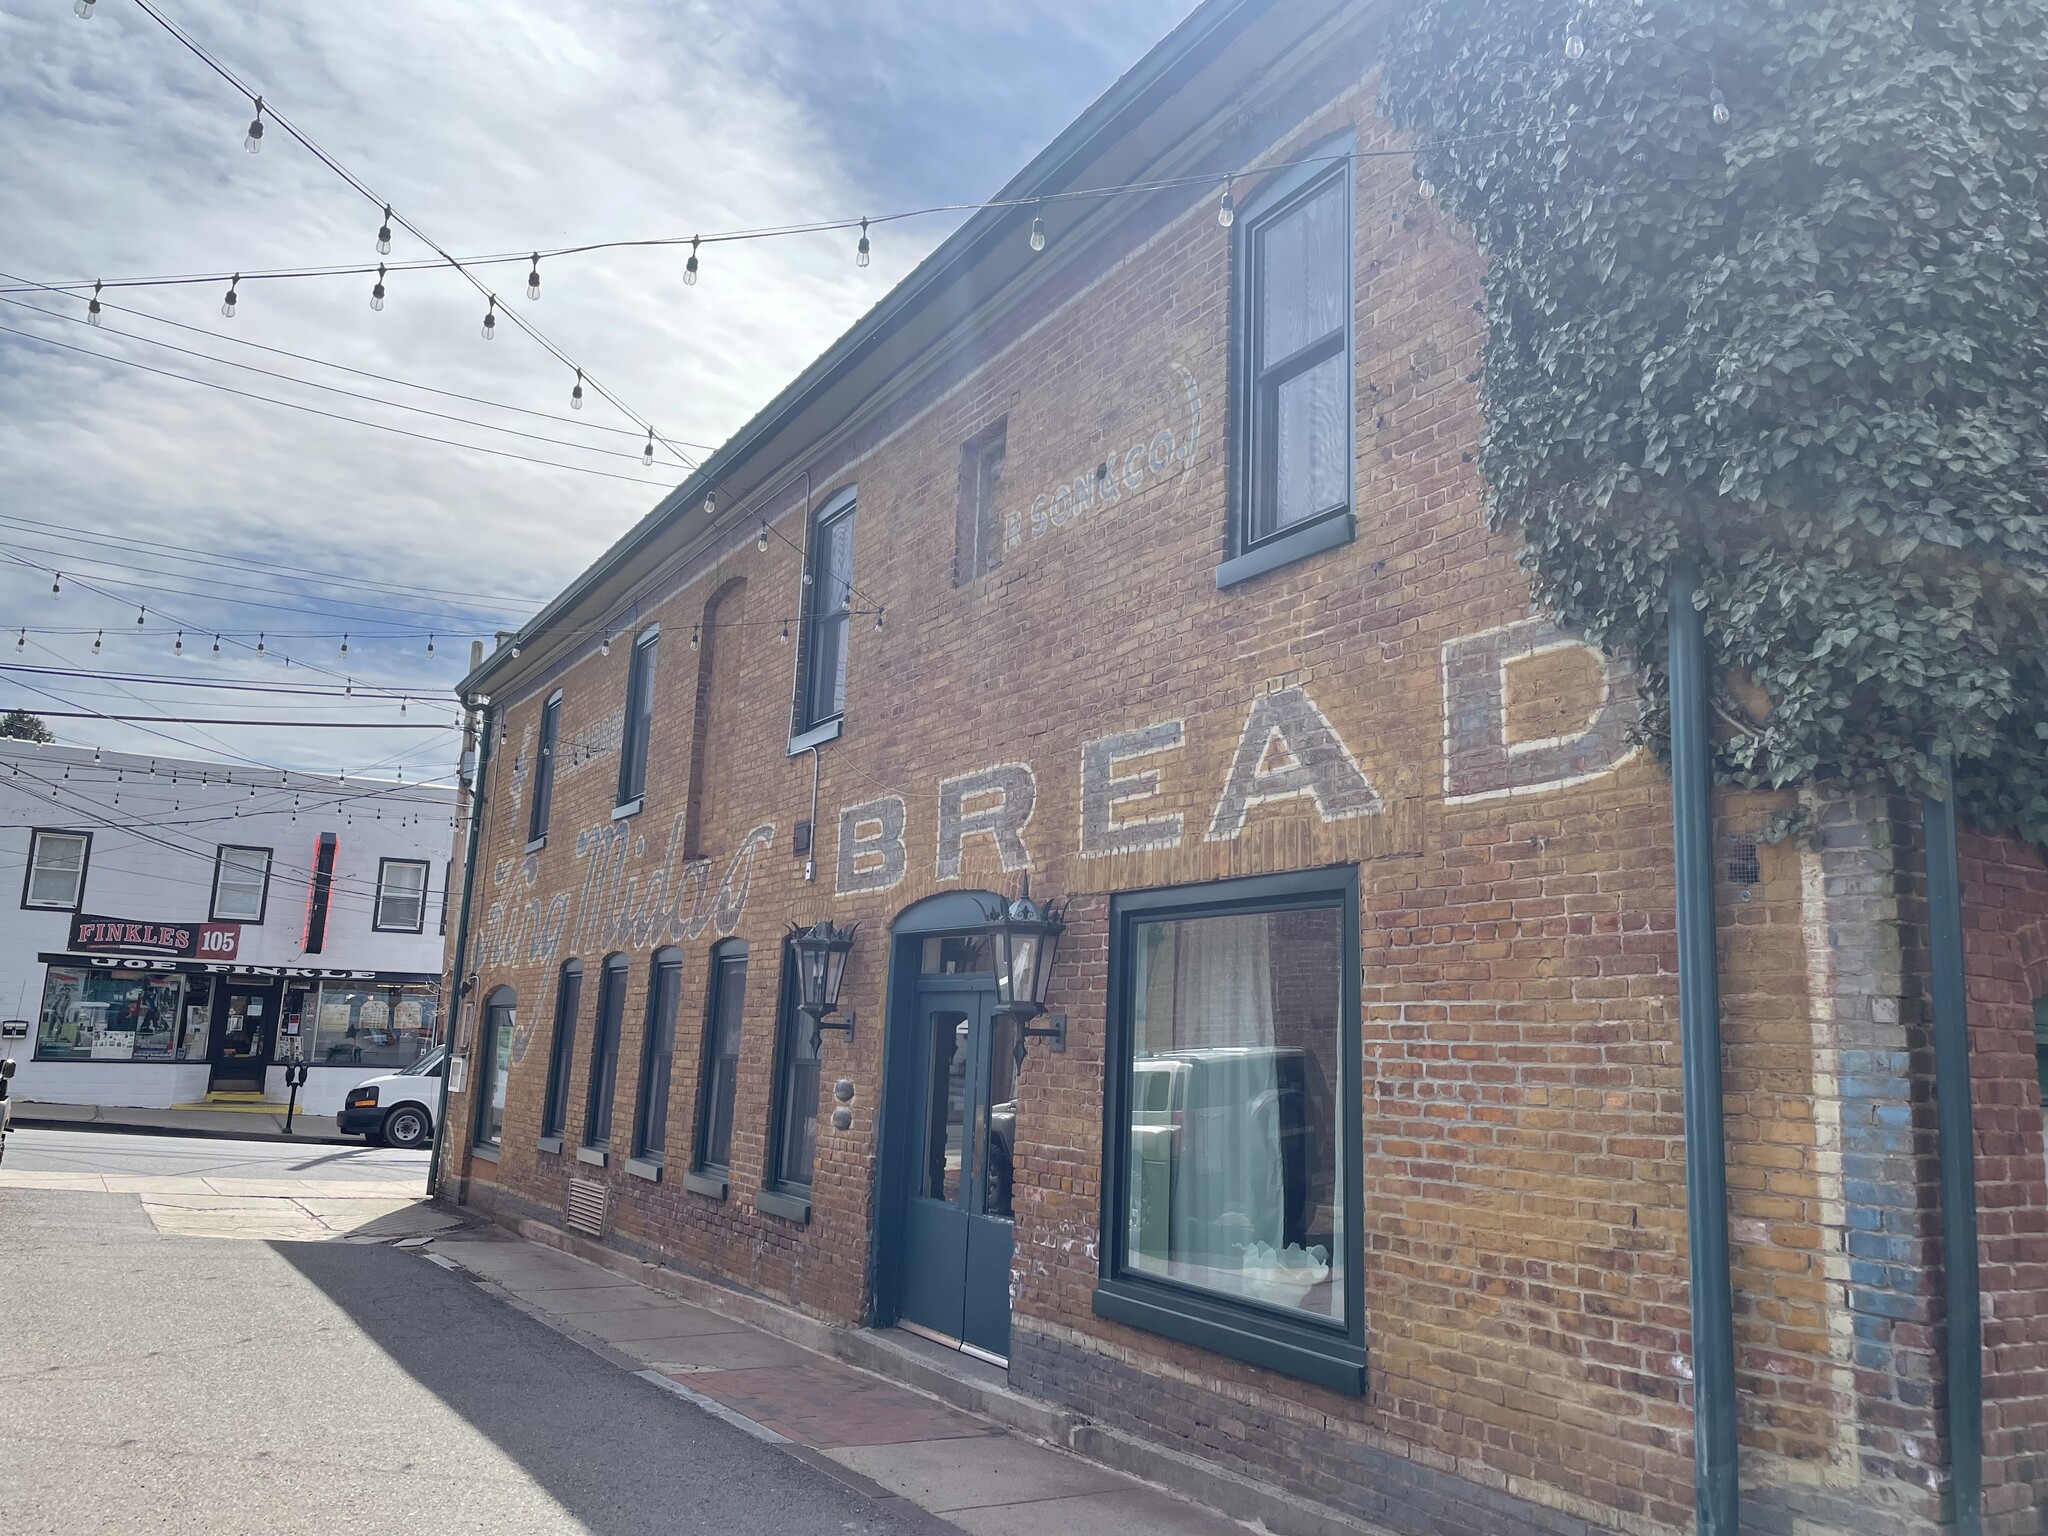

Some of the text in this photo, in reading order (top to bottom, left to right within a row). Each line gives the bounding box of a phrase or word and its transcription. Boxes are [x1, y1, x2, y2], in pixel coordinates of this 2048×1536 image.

[834, 612, 1642, 896] BREAD
[77, 923, 190, 949] FINKLES
[201, 930, 235, 953] 105
[90, 958, 377, 980] JOE FINKLE
